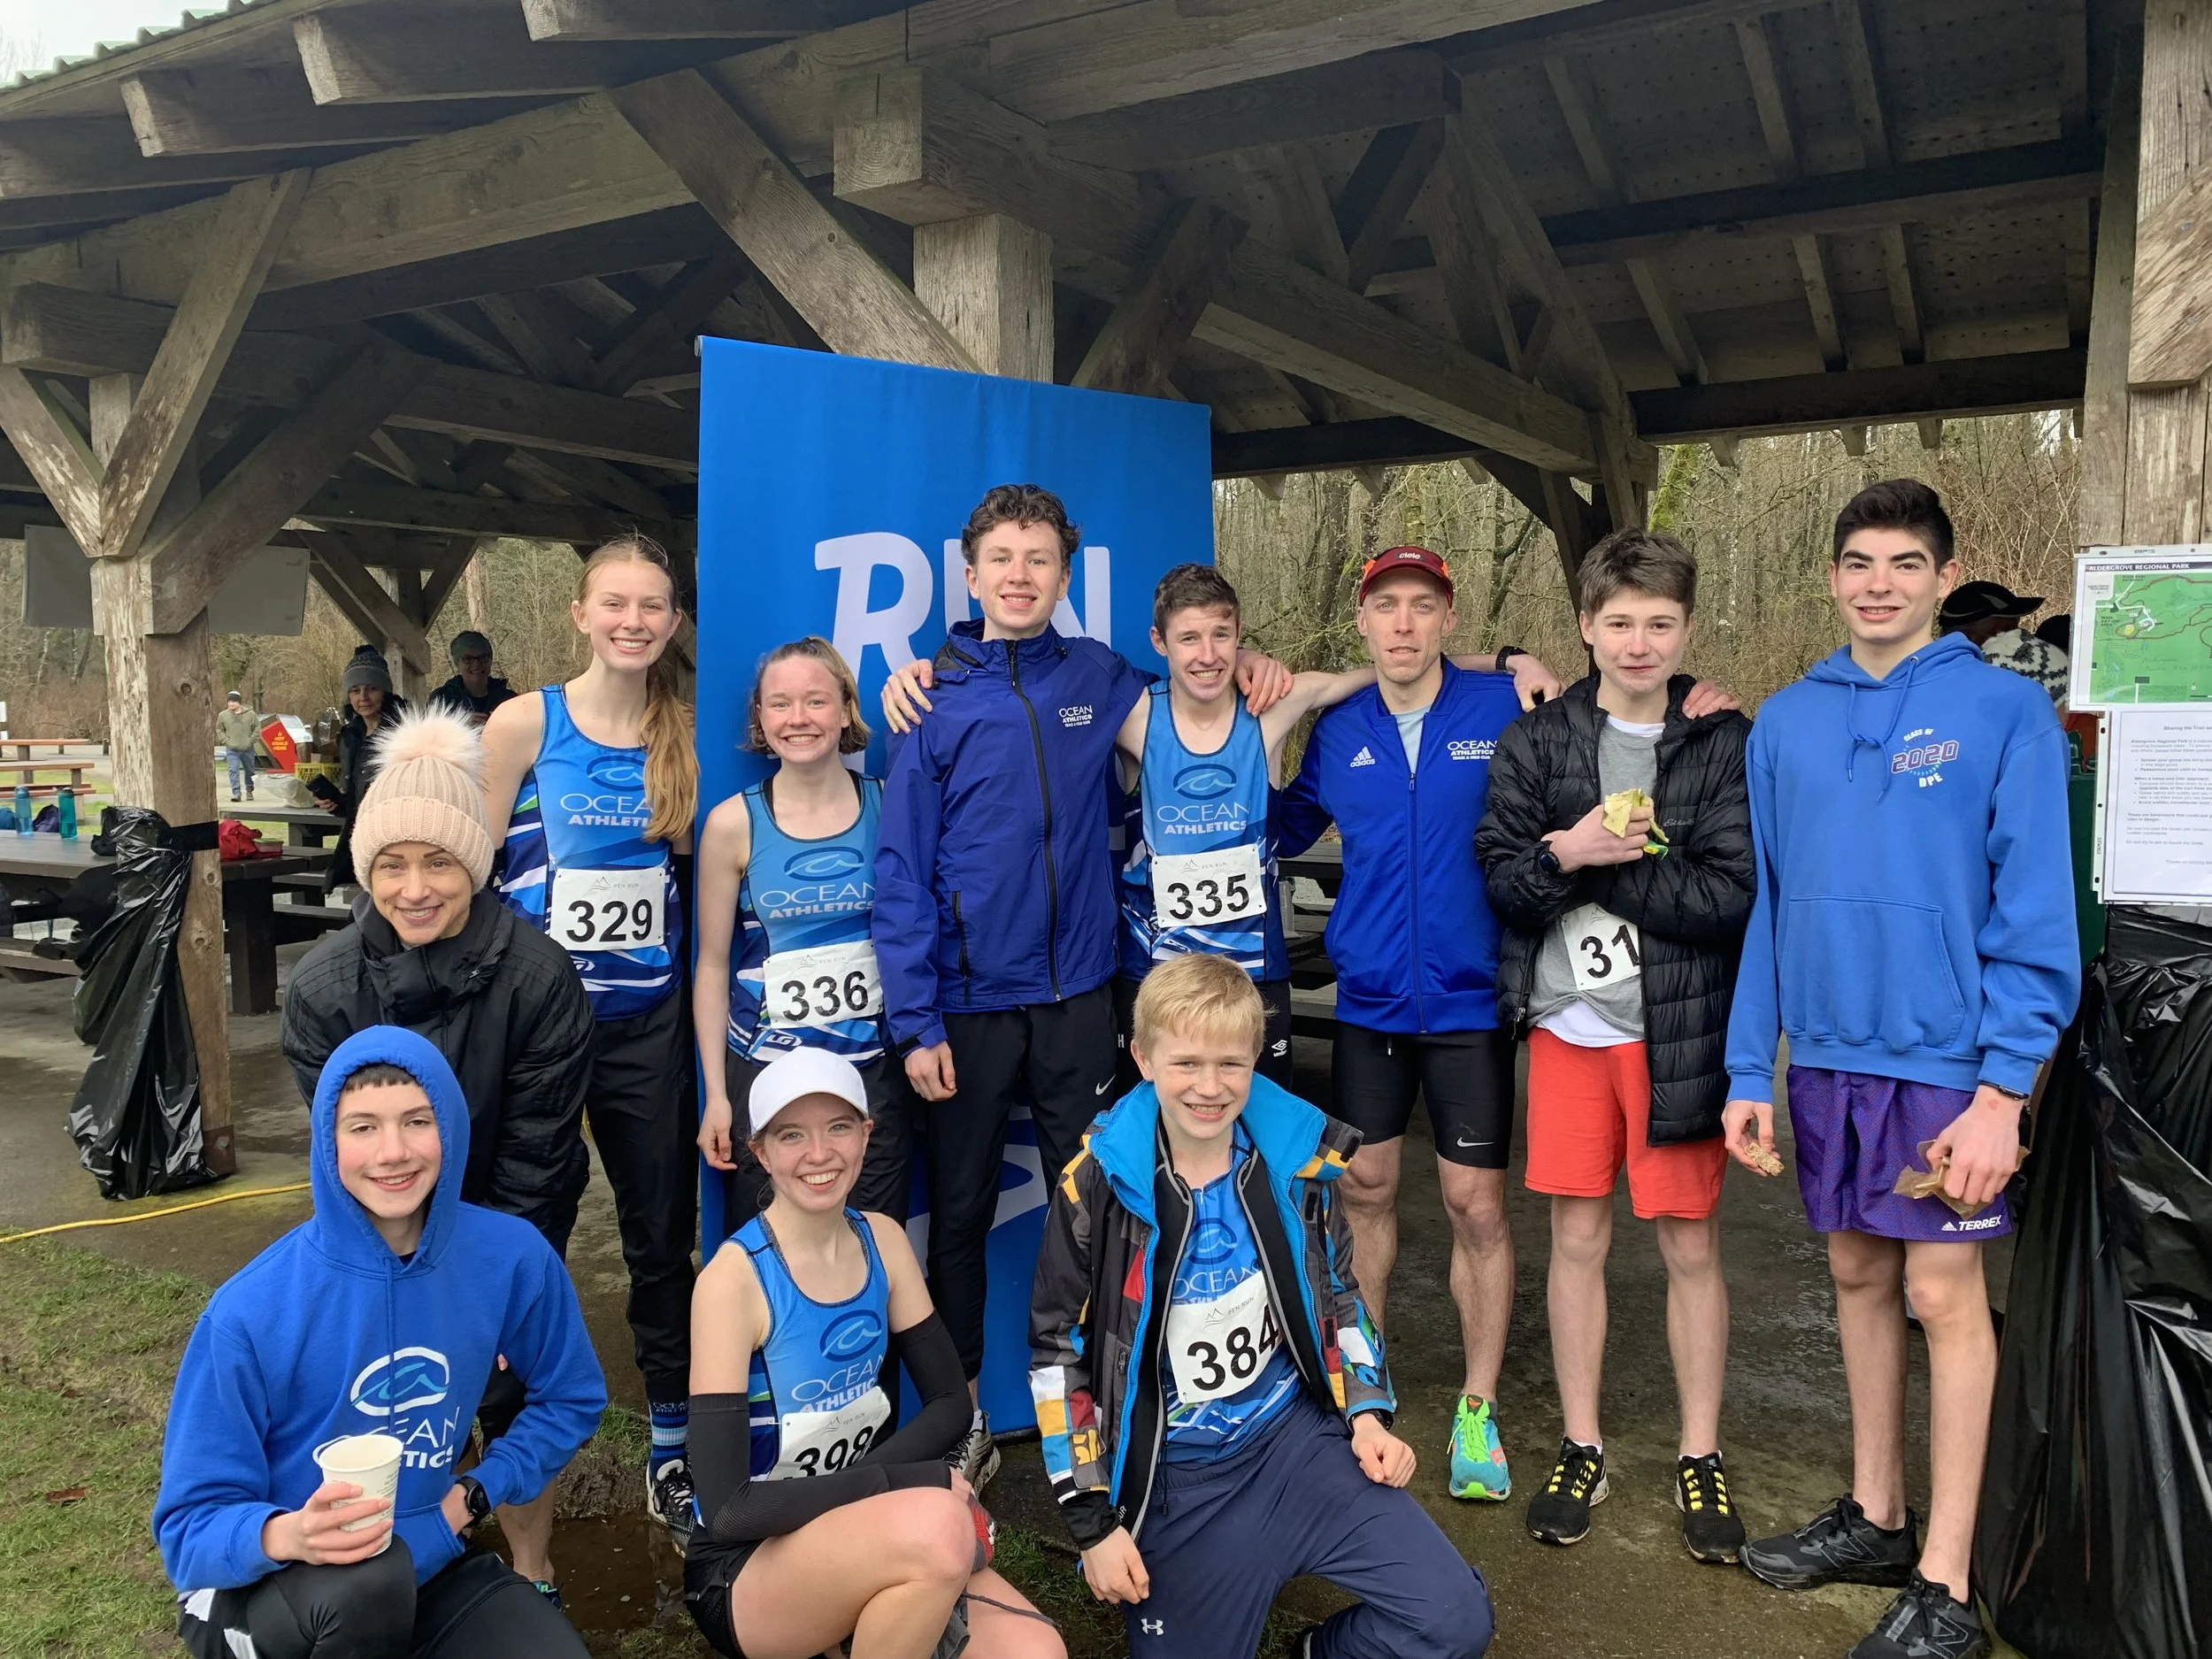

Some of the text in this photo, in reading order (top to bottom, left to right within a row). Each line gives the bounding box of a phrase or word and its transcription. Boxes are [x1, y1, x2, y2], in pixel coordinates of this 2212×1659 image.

[1059, 704, 1093, 718] OCEAN
[1063, 714, 1093, 724] ATHLETICS
[1903, 729, 1923, 741] CLASS
[1448, 740, 1497, 750] OCEAN
[1350, 758, 1375, 767] adidas
[1891, 740, 1959, 774] 2020
[560, 793, 653, 815] OCEA
[1156, 800, 1250, 822] OCEAN
[567, 815, 649, 828] ATHLETI
[1164, 820, 1247, 834] ATHLETICS
[1167, 873, 1249, 920] 335
[769, 900, 874, 919] ATHLETICS
[566, 899, 653, 942] 329
[781, 971, 869, 1022] 336
[1958, 1215, 2001, 1231] TERREX
[1241, 1296, 1254, 1307] RUN
[1187, 1303, 1279, 1391] 384
[798, 1377, 876, 1413] ATHLETIC
[783, 1425, 873, 1479] 398
